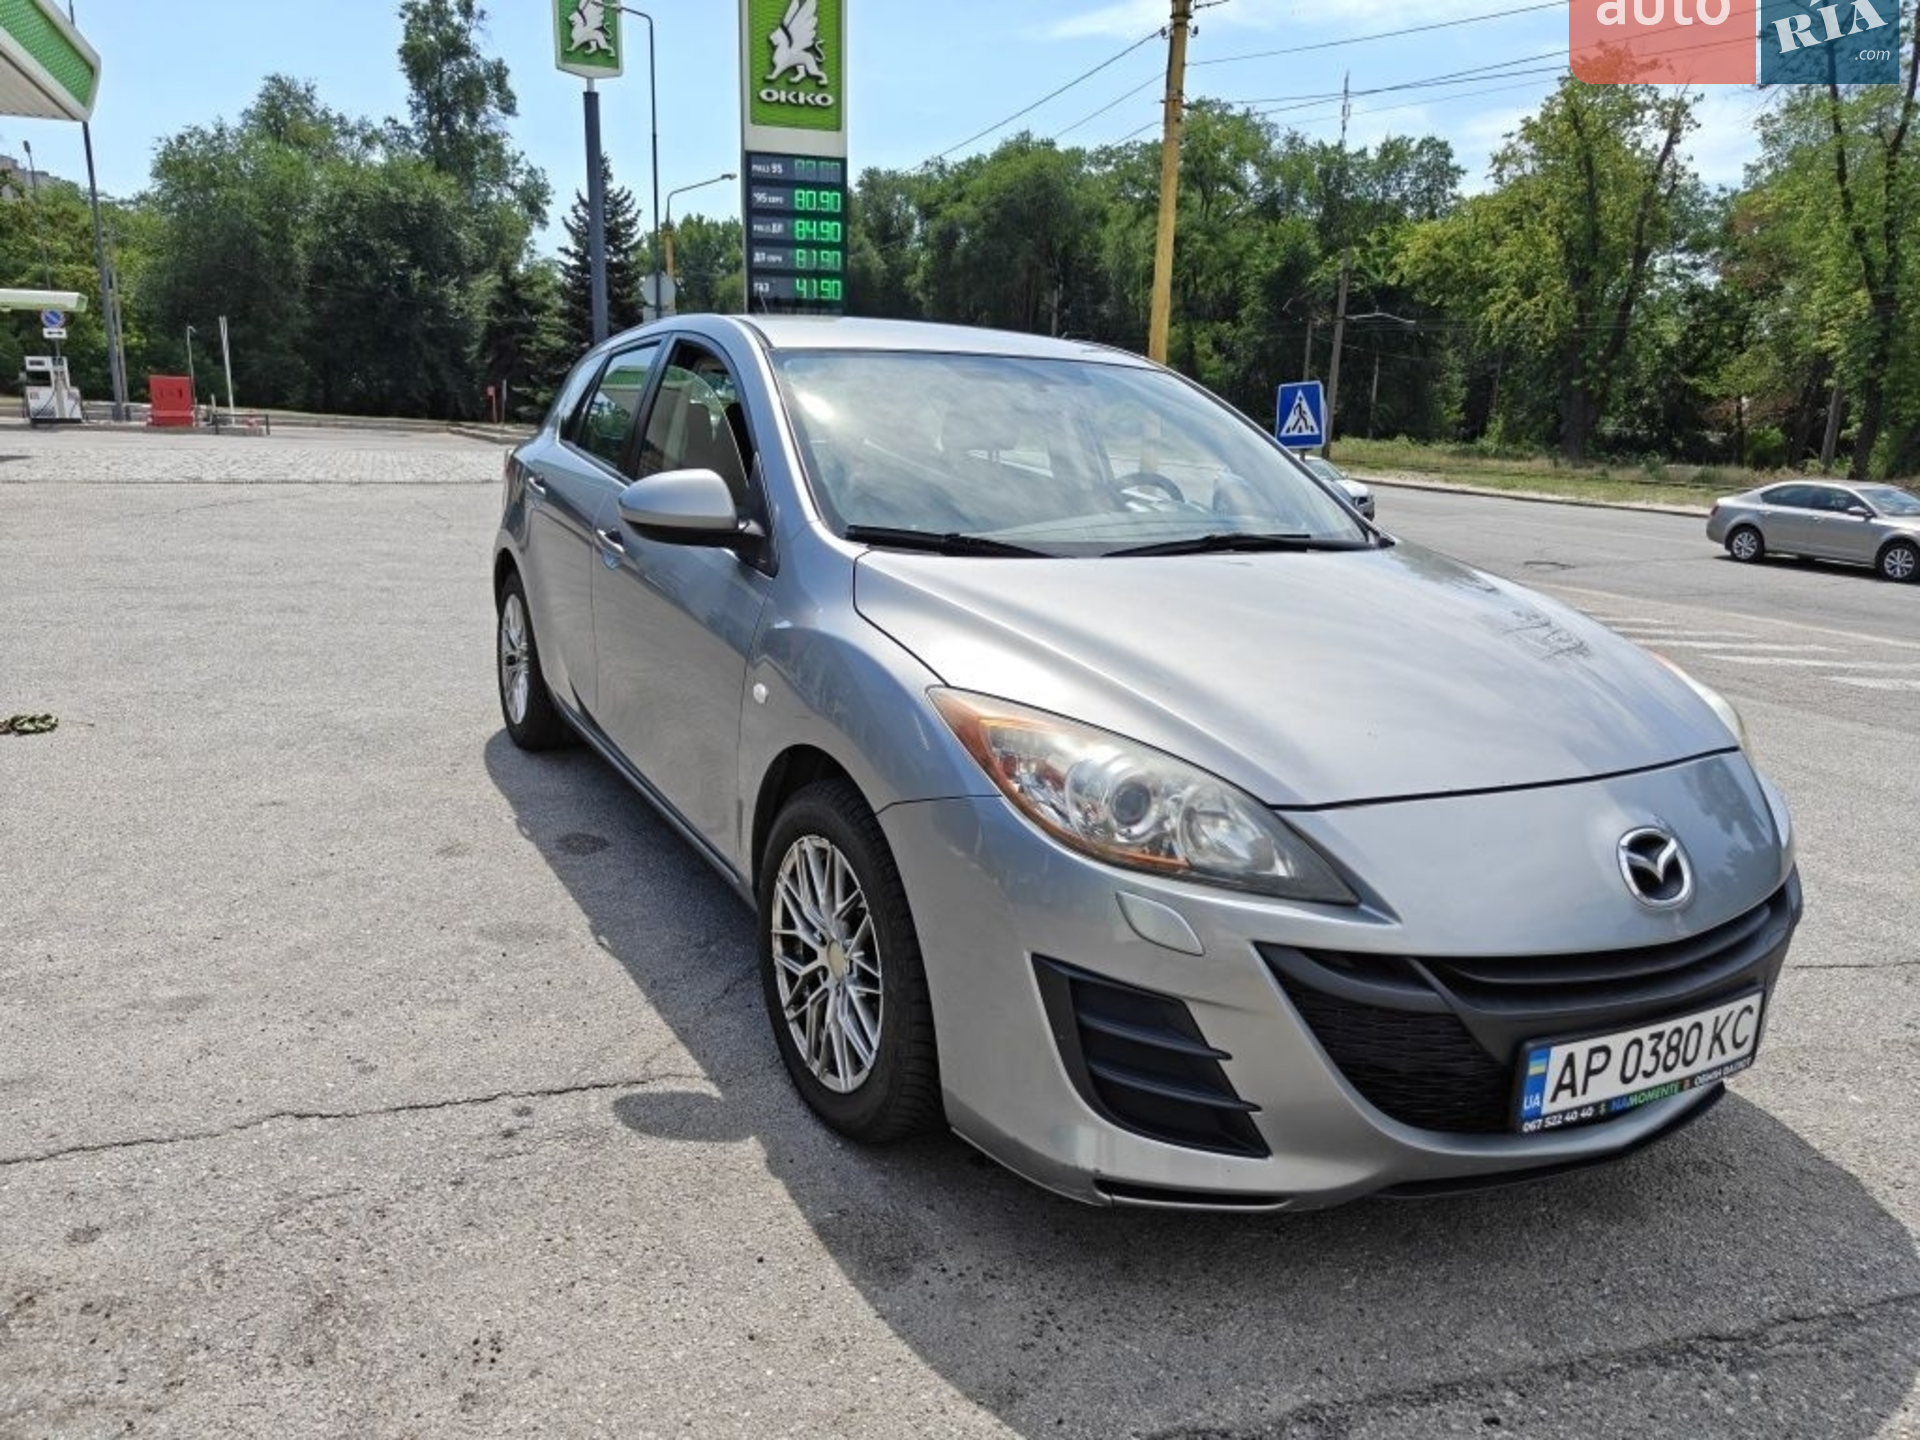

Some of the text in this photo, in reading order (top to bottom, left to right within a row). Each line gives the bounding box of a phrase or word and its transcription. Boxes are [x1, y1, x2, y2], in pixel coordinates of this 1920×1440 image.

[759, 88, 834, 107] OKKO
[794, 189, 841, 213] 80.90
[794, 220, 841, 242] 84.90
[1550, 1004, 1754, 1103] AP 0380 KC
[1523, 1093, 1541, 1110] UA
[1522, 1115, 1543, 1133] 067
[1544, 1110, 1563, 1129] 522
[1564, 1107, 1579, 1123] 40
[1580, 1104, 1594, 1119] 40
